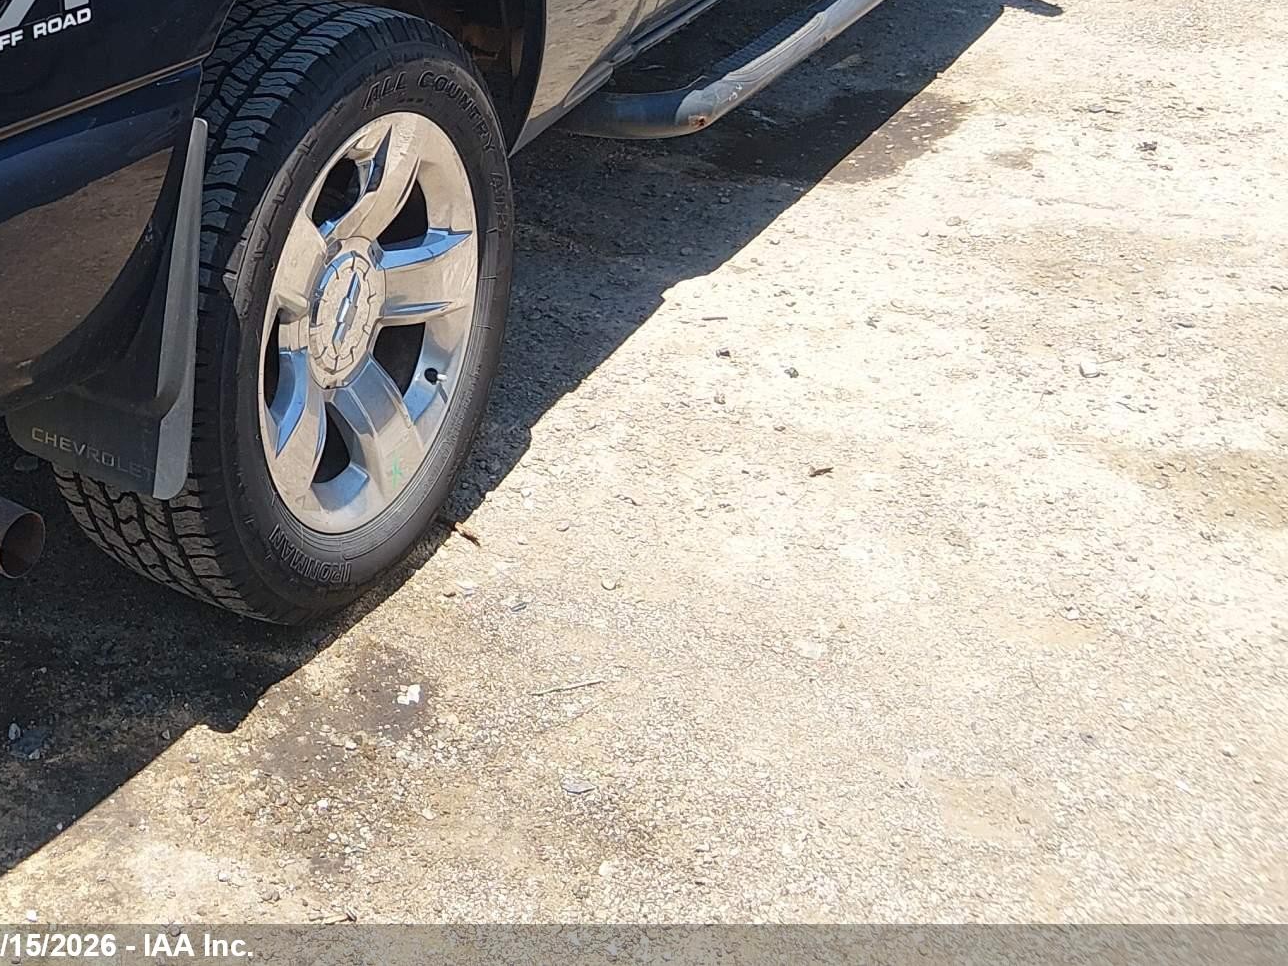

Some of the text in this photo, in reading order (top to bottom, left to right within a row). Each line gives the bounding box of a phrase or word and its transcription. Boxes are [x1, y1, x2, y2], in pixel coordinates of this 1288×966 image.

[33, 7, 92, 39] ROAD
[363, 69, 497, 154] ALL COUNTRY
[267, 523, 352, 584] IRONMAN
